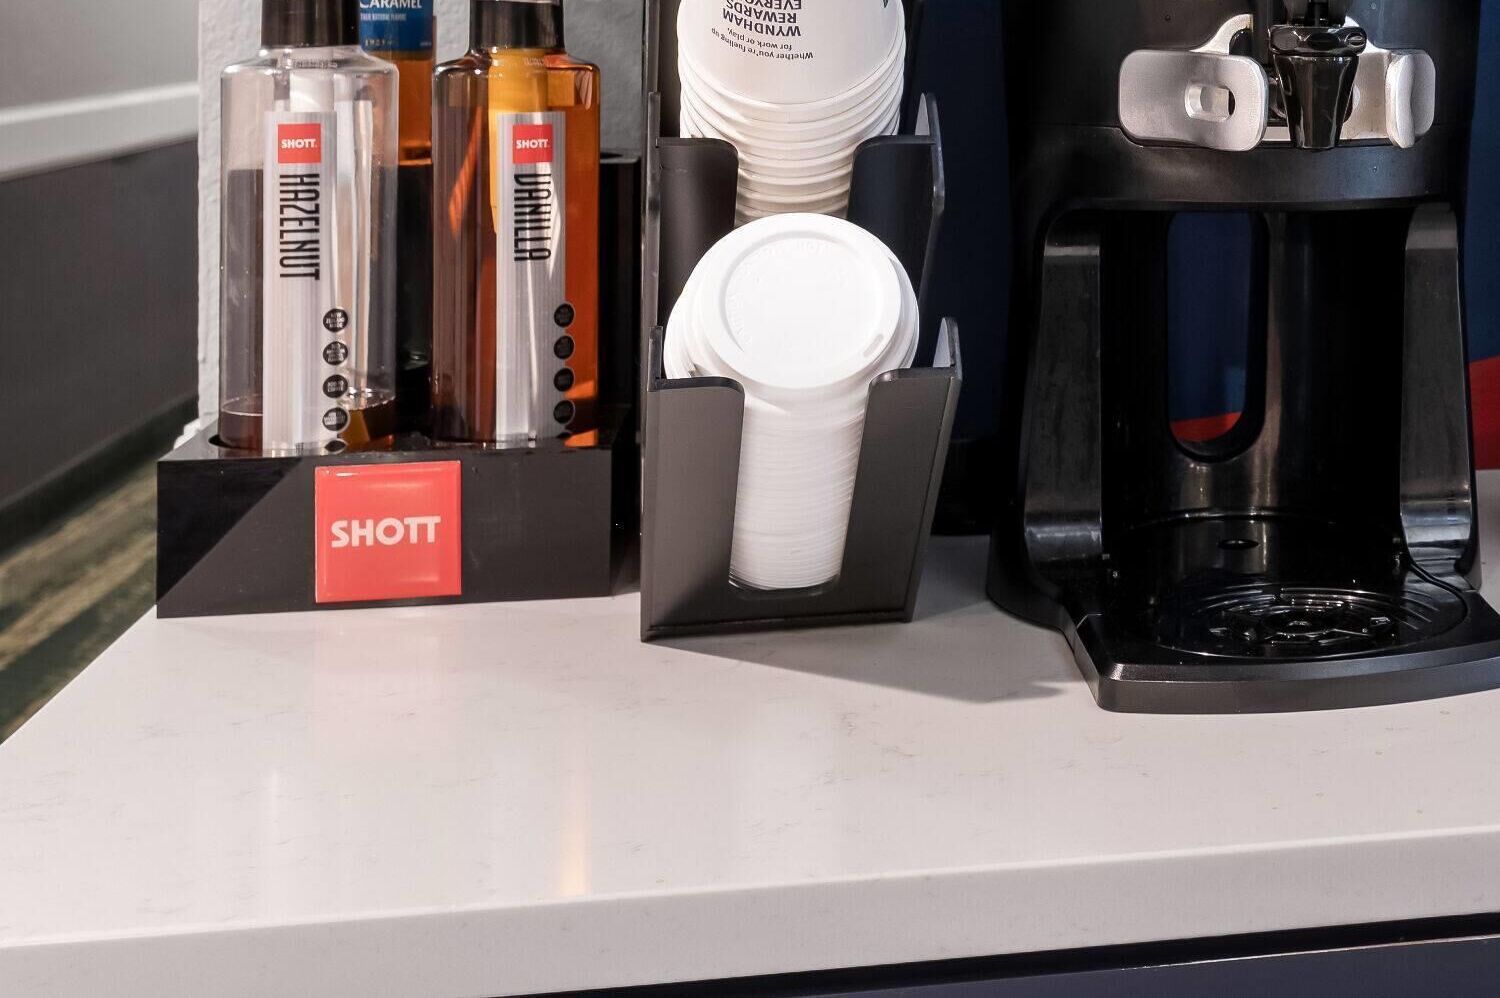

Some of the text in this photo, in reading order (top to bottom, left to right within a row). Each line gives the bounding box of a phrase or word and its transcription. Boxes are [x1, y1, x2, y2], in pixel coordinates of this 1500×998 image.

[723, 8, 801, 37] WYNDHAM
[757, 40, 778, 49] work
[776, 52, 813, 60] Whether
[281, 138, 316, 149] SHOTT
[516, 139, 548, 149] SHOTT
[279, 173, 320, 281] HAZELNUT
[514, 173, 552, 261] VANILLA
[331, 515, 441, 548] SHOTT
